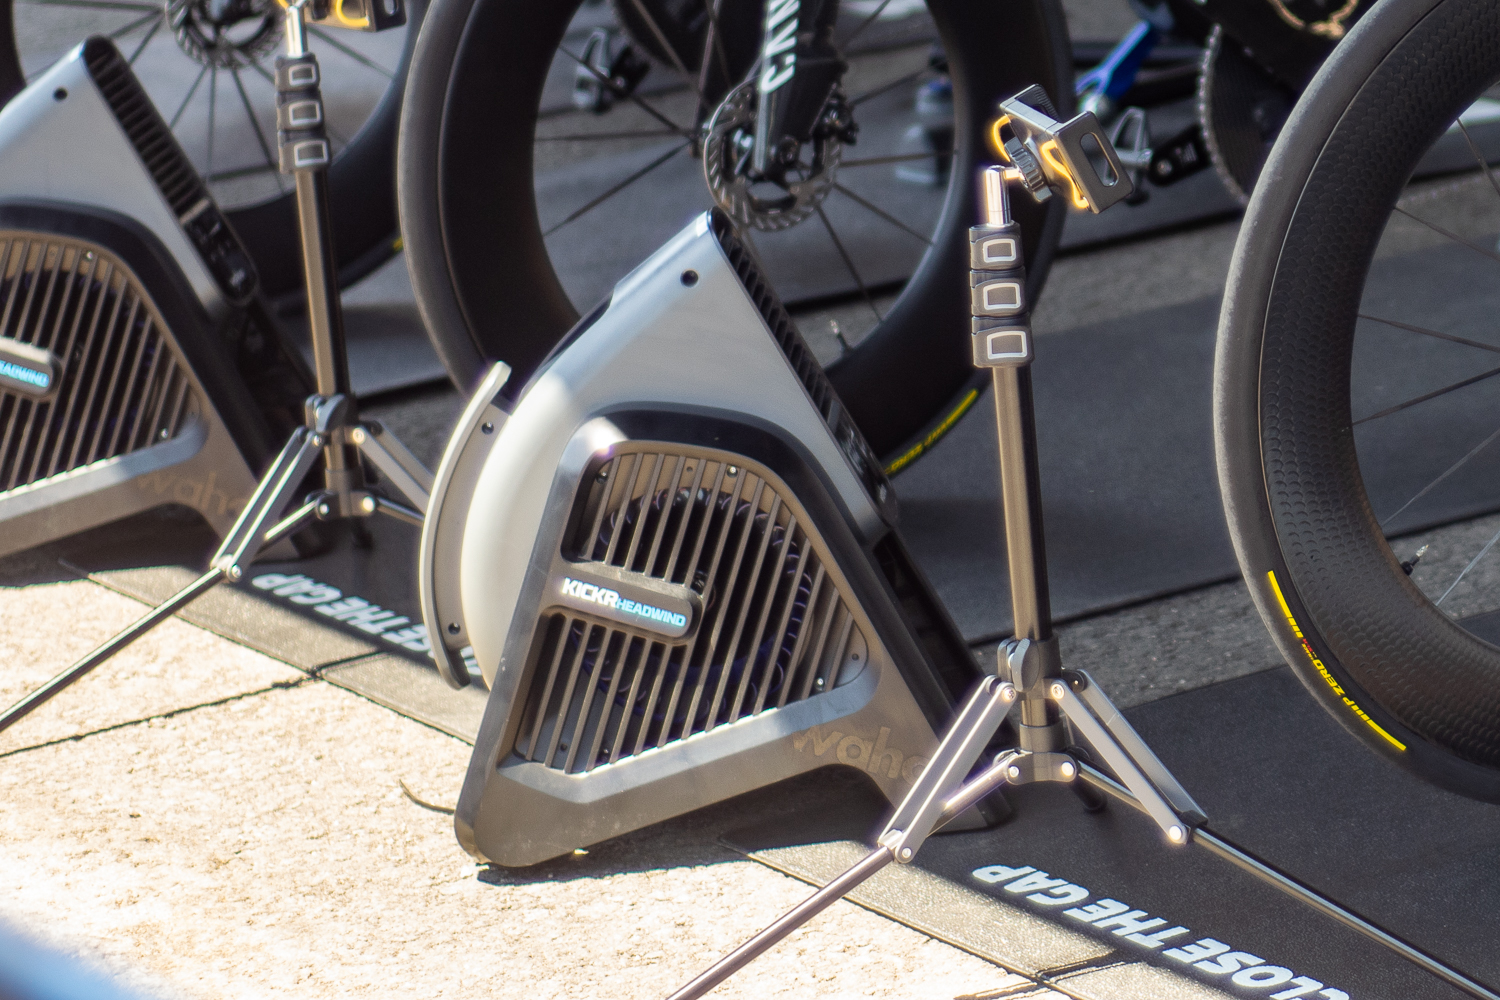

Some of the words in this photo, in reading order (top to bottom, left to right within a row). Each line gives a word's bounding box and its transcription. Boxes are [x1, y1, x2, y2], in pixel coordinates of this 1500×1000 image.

[251, 572, 343, 605] GAP
[561, 576, 620, 609] KICKR
[614, 597, 687, 628] HEADWIND
[313, 595, 410, 635] THE
[1312, 658, 1346, 697] ZERO
[792, 724, 930, 786] waho
[971, 863, 1090, 907] GAP
[1062, 897, 1191, 950] THE
